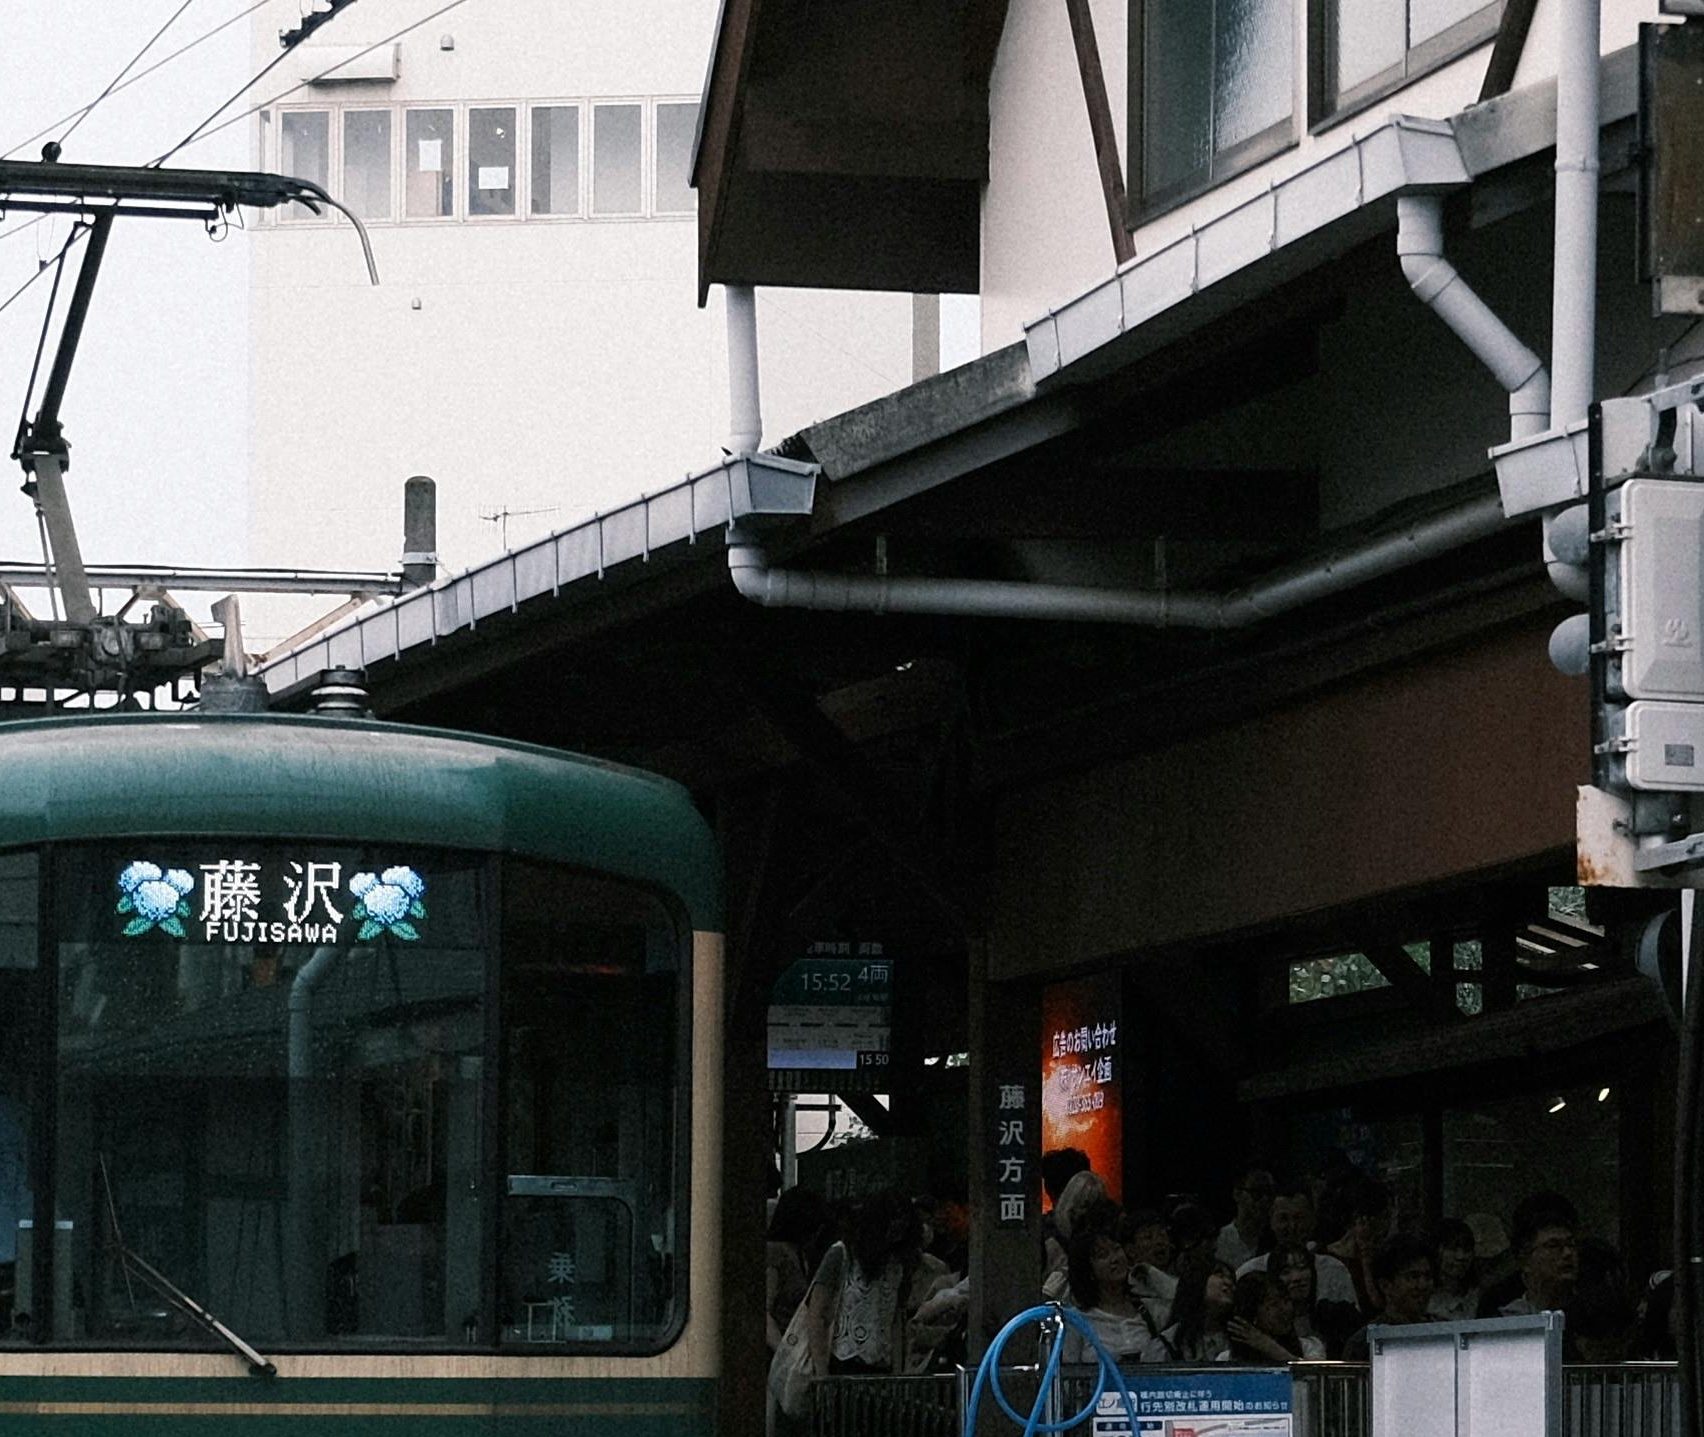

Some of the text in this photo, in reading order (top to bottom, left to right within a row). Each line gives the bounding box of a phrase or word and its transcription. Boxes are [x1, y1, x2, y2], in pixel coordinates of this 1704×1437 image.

[199, 859, 345, 924] 藤沢
[206, 922, 338, 944] FUJISAWA
[801, 972, 852, 991] 15:52
[998, 1085, 1026, 1221] 藤沢方面
